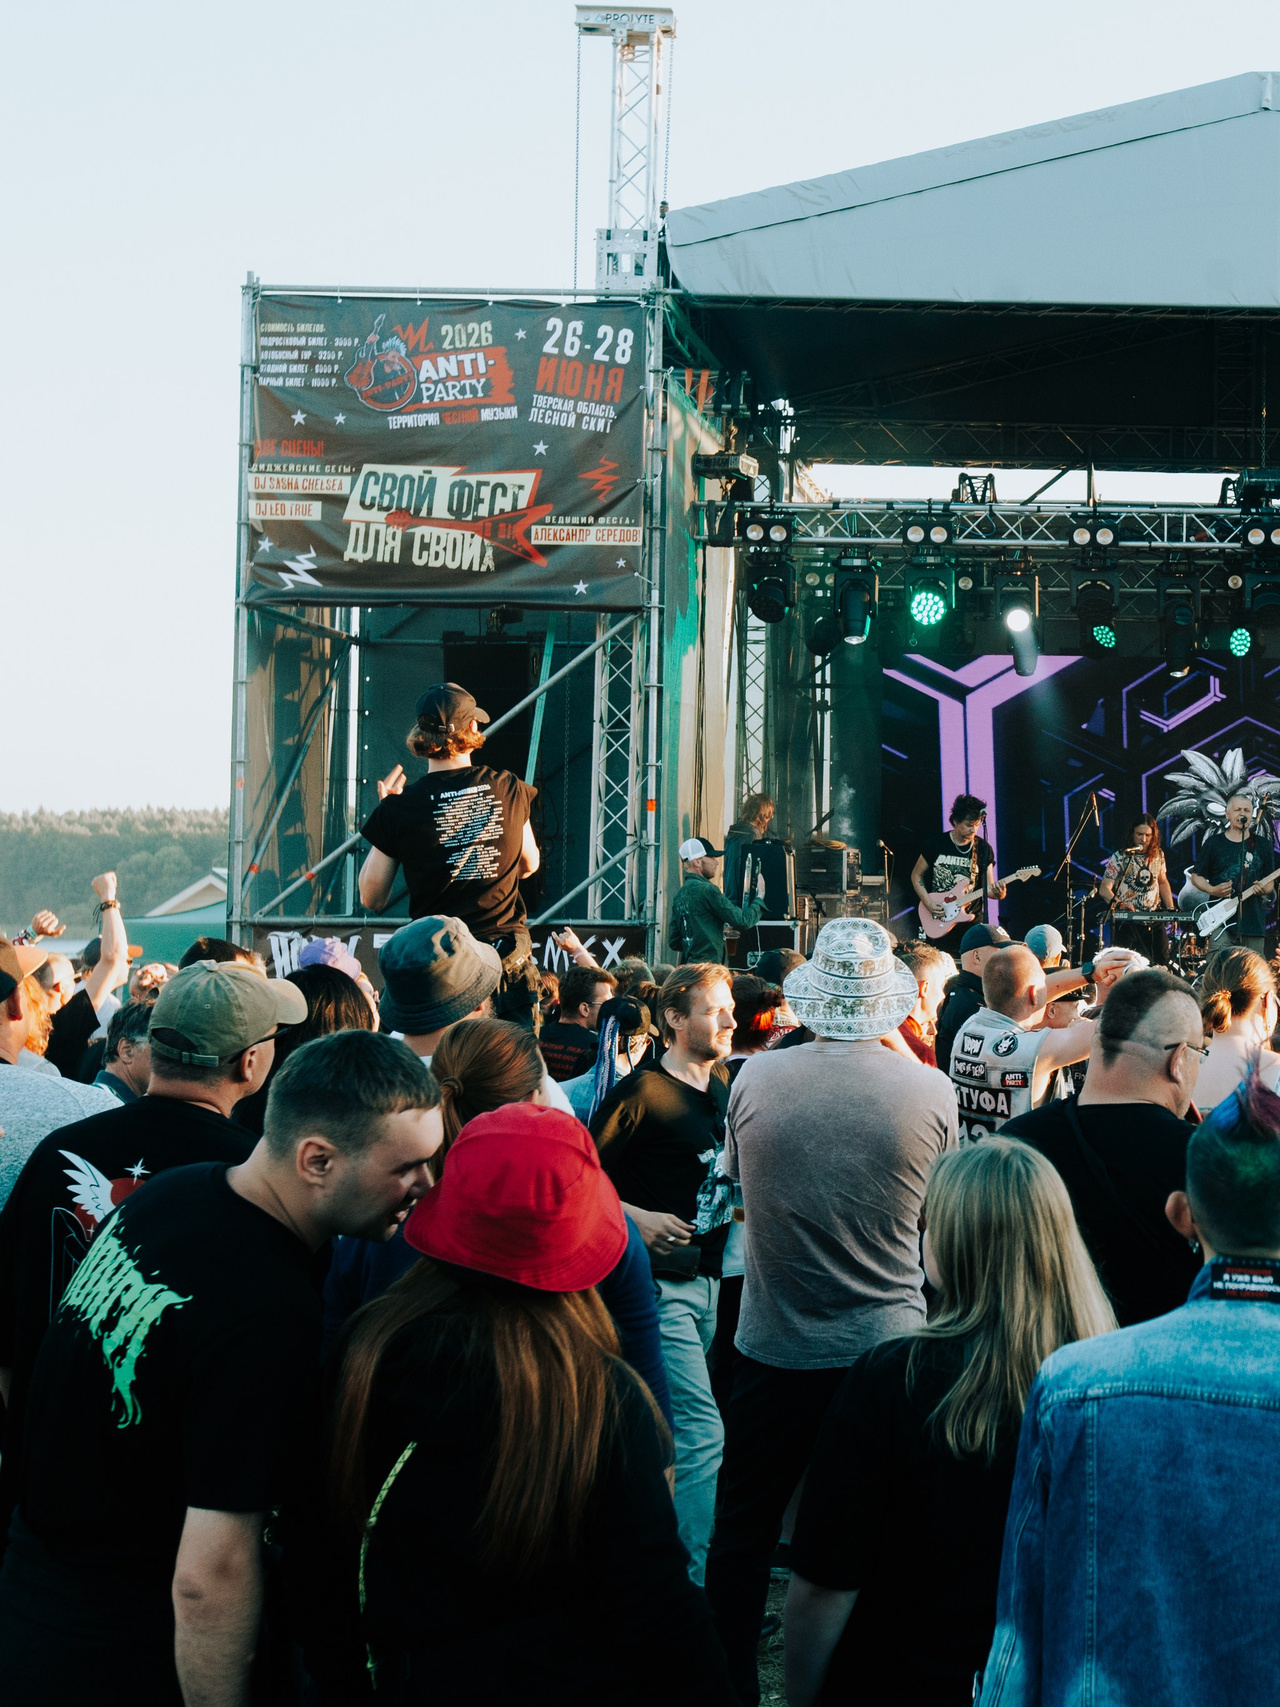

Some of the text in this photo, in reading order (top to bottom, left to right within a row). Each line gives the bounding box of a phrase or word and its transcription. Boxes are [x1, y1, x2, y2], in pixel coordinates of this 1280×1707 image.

[605, 13, 655, 24] PROLYTE
[441, 320, 493, 350] 2026
[542, 317, 634, 365] 26-28
[418, 352, 495, 382] ANTI-
[536, 356, 625, 403] ИЮНЯ
[421, 378, 486, 404] PARTY
[532, 394, 575, 412] ТВЕРСКАЯ
[387, 412, 440, 430] ТЕРРИТОРИЯ
[480, 406, 518, 421] МУЗЫКИ
[528, 407, 613, 433] ЛЕСНОЙ СКИТ
[281, 439, 325, 458] СЦЕНЫ!
[251, 463, 321, 473] ДИДЖЕЙСКИЕ
[254, 476, 343, 491] DJ SASHA CHELSEA
[359, 469, 525, 522] СВОЙ ФЕСТ
[255, 502, 313, 517] DJ LEO TRUE
[545, 515, 595, 525] ВЕДУЩИЙ
[343, 522, 403, 564] ДЛЯ
[533, 527, 641, 543] АЛЕКСАНДР СЕРЕДОВ!
[934, 854, 971, 867] PANTER
